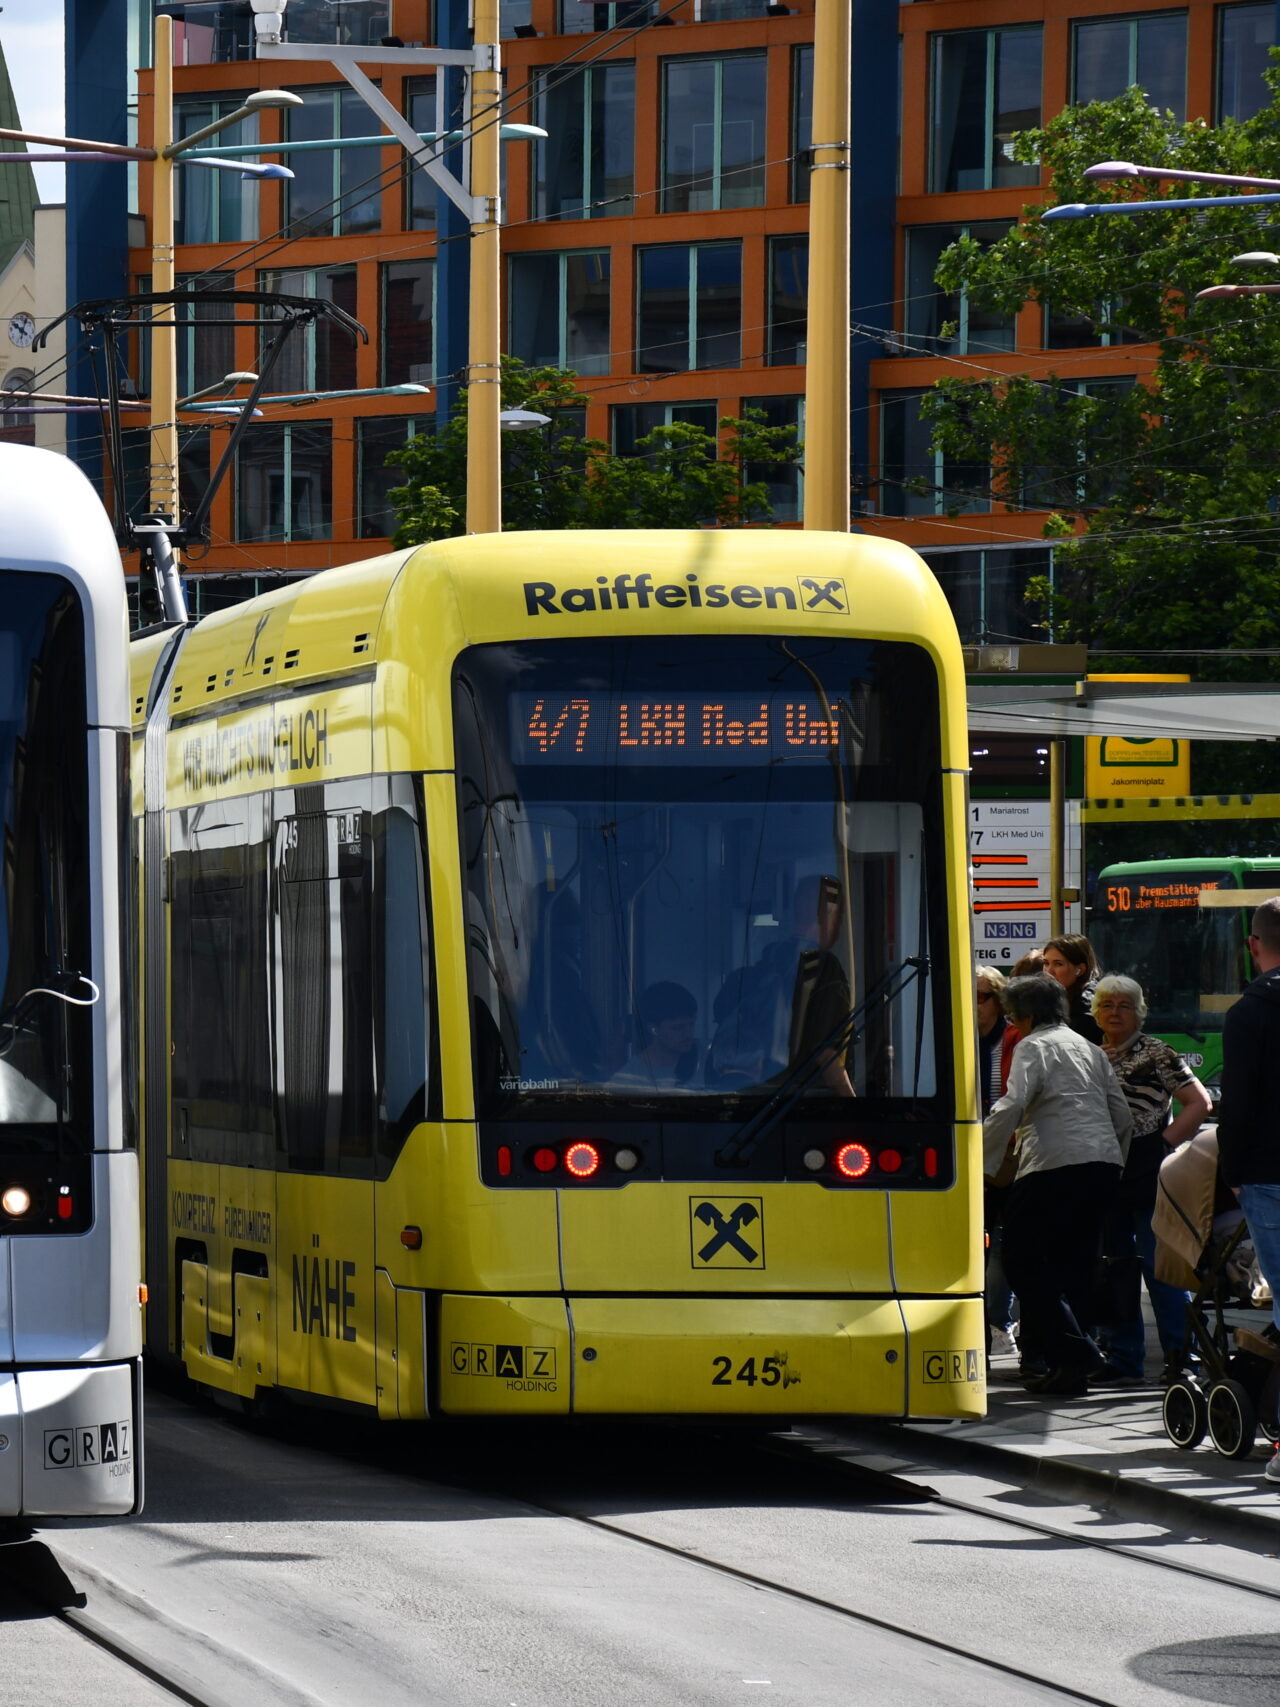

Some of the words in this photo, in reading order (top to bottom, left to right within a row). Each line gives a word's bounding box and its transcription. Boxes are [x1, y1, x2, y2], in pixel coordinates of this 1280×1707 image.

[523, 573, 798, 617] Raiffeisen
[528, 699, 590, 752] 4/7
[620, 704, 685, 745] LKH
[1111, 777, 1166, 787] Jakominiplatz
[971, 806, 980, 822] 1
[989, 806, 1030, 815] Mariatrost
[991, 830, 1009, 839] LKH
[1010, 830, 1029, 839] Med
[1030, 830, 1045, 839] Uni
[1107, 886, 1131, 912] 510
[986, 923, 1009, 937] N3
[1011, 923, 1035, 937] N6
[974, 949, 997, 960] TEIG
[1001, 947, 1011, 959] G
[500, 1078, 559, 1090] variobahn
[292, 1233, 357, 1343] NÄHE
[451, 1343, 556, 1379] GRAZ
[711, 1355, 782, 1387] 245
[506, 1380, 558, 1393] HOLDING
[45, 1420, 131, 1470] GRAZ
[108, 1462, 131, 1478] HOLDING
